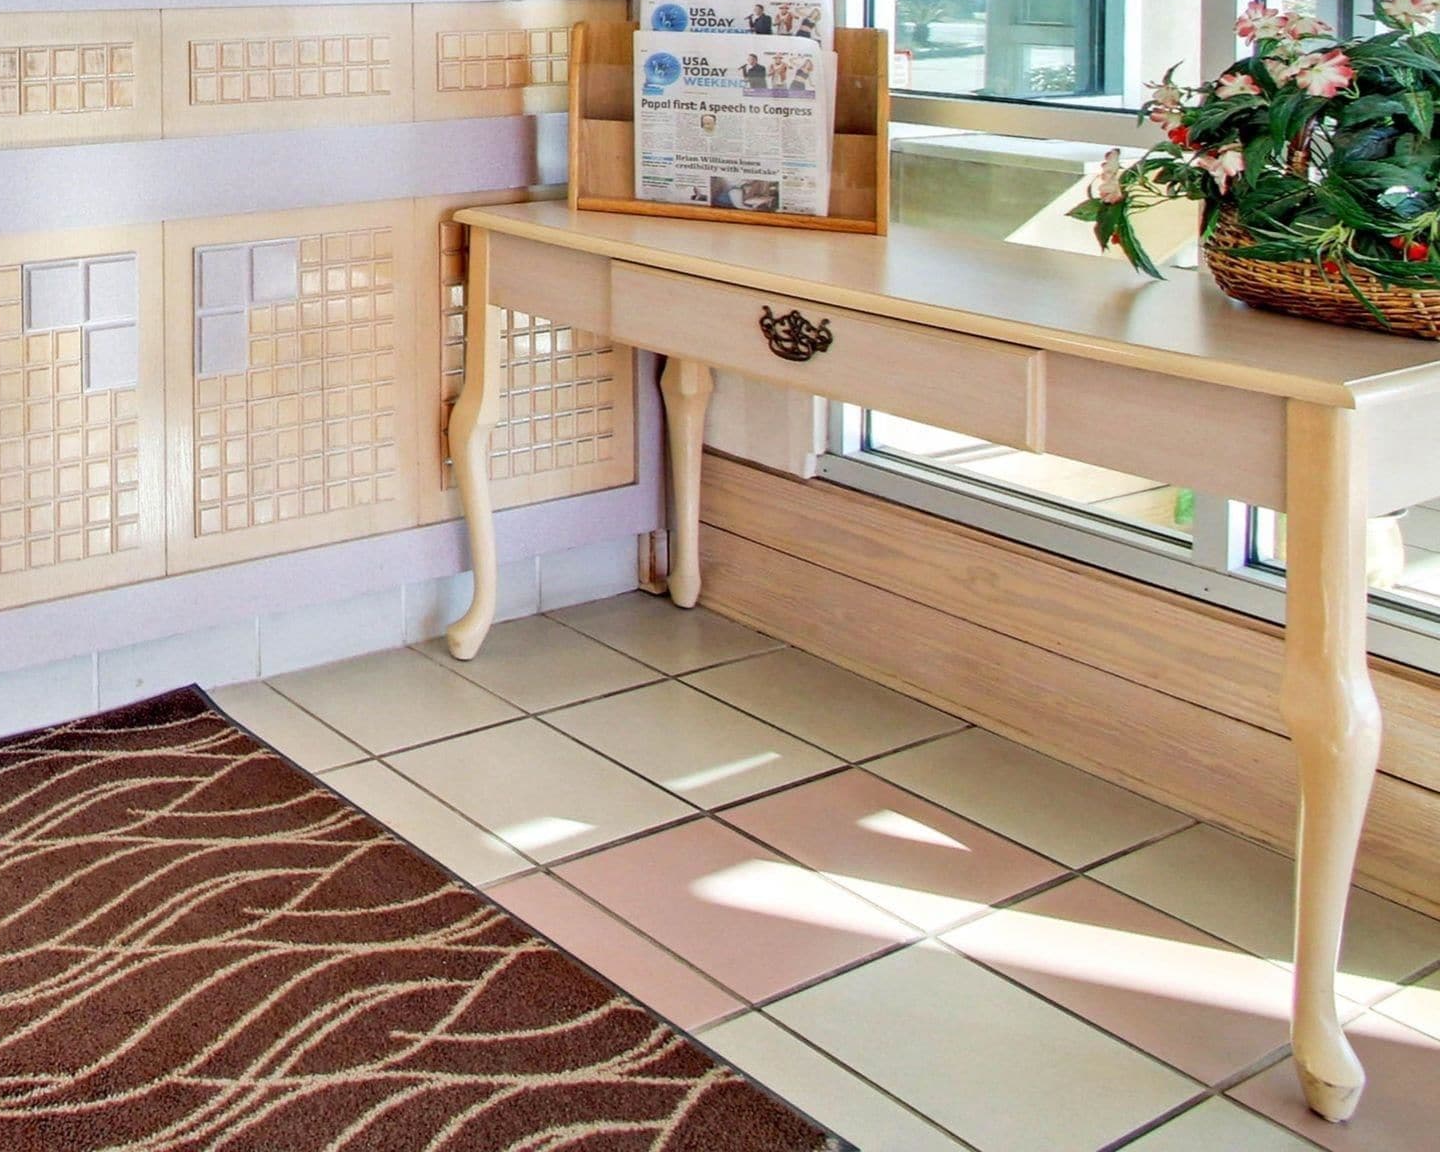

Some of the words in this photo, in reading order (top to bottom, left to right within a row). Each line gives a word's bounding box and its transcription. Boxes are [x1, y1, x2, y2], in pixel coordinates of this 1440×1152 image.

[689, 7, 716, 17] USA
[690, 17, 734, 27] TODAY
[682, 56, 709, 66] USA
[683, 66, 727, 77] TODAY
[683, 76, 748, 88] WEEKEND
[641, 98, 671, 110] Papal
[673, 99, 698, 111] first:
[699, 101, 707, 111] A
[709, 103, 746, 114] speech
[749, 104, 760, 114] to
[763, 104, 813, 118] Congress
[700, 155, 738, 165] Williams
[675, 163, 718, 173] credibility
